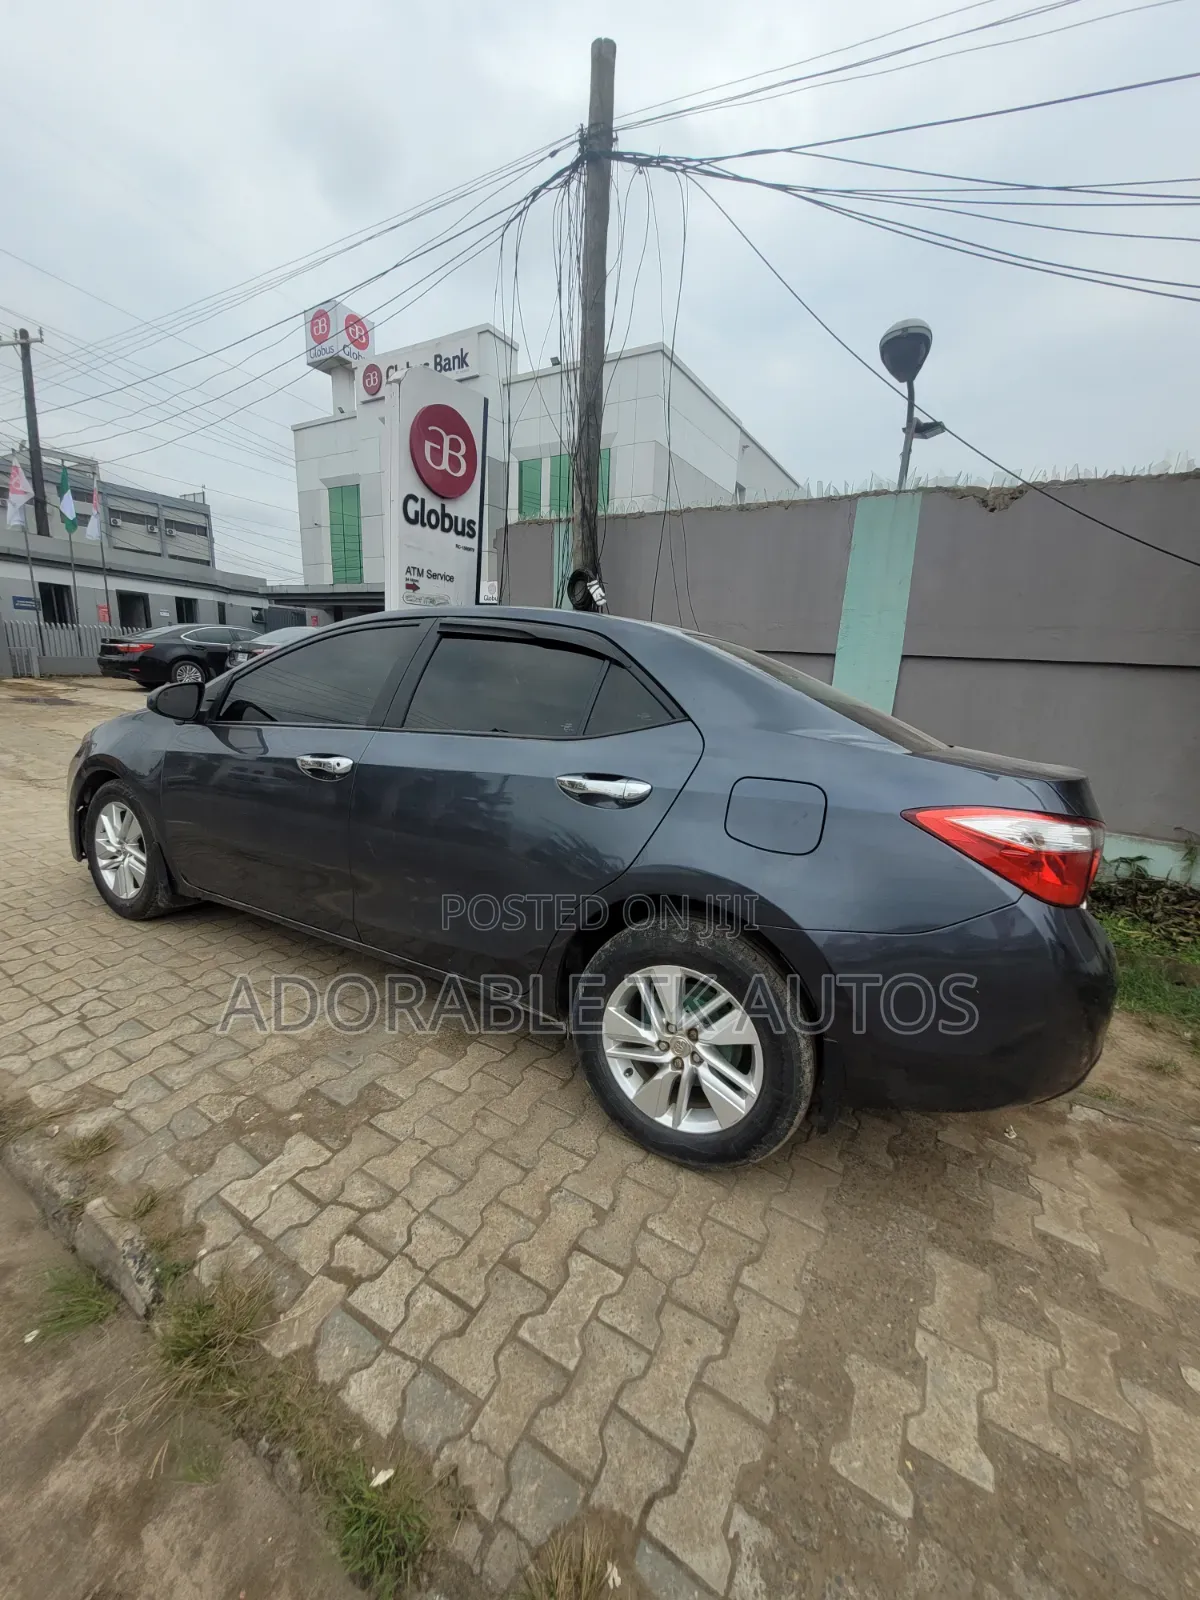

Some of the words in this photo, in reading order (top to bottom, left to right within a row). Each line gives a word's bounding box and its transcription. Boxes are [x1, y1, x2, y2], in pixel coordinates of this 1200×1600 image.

[433, 347, 470, 374] Bank
[402, 493, 477, 539] Globus
[405, 565, 425, 578] ATM
[426, 569, 455, 583] Service
